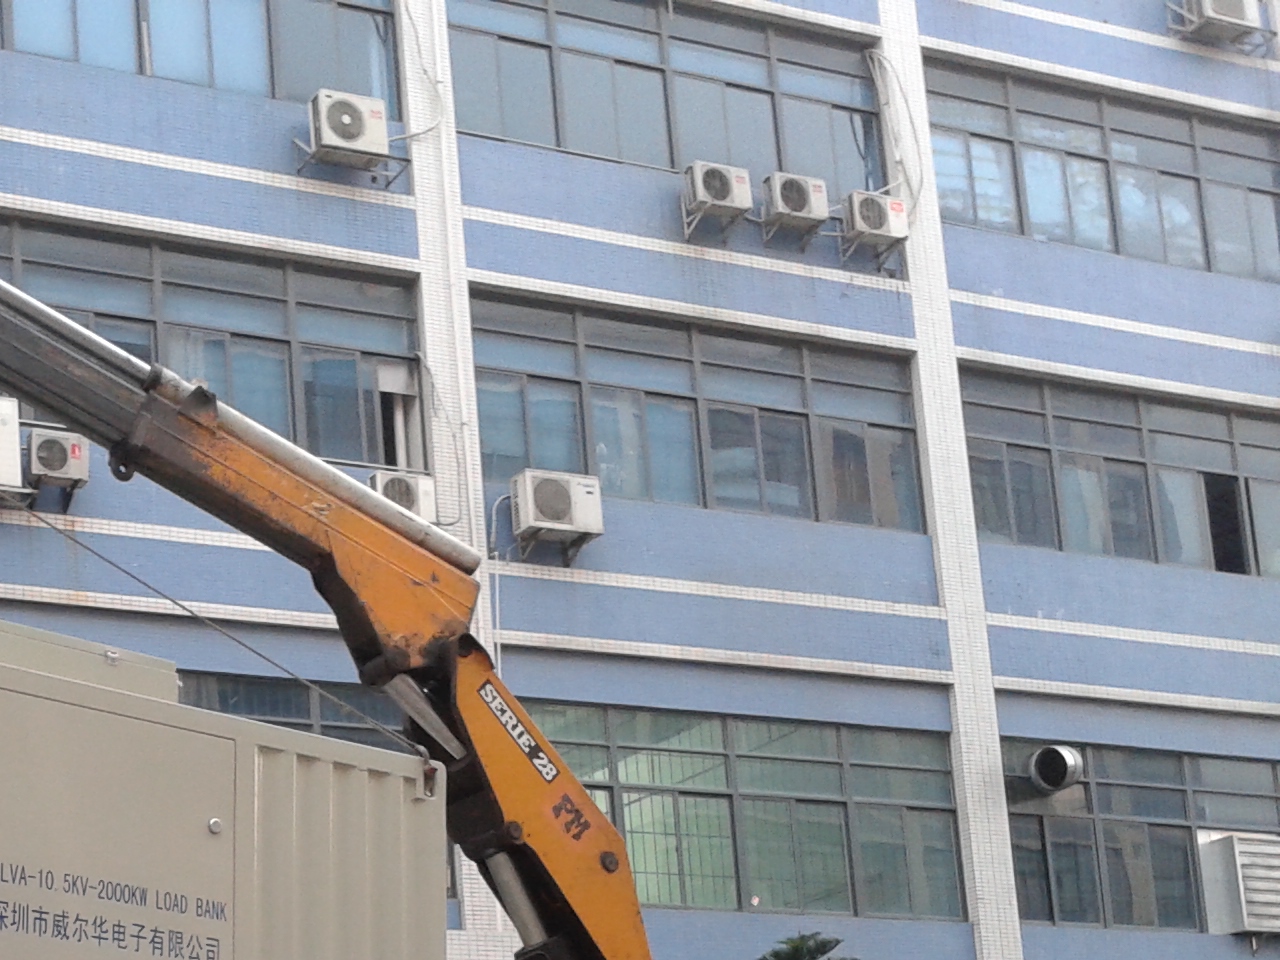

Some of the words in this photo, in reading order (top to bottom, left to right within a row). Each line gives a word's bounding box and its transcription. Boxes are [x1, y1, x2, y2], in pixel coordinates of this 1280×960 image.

[479, 683, 537, 754] SERIE
[532, 752, 558, 781] 28
[552, 793, 591, 841] PM
[155, 889, 188, 914] LOAD
[196, 898, 228, 922] BANK
